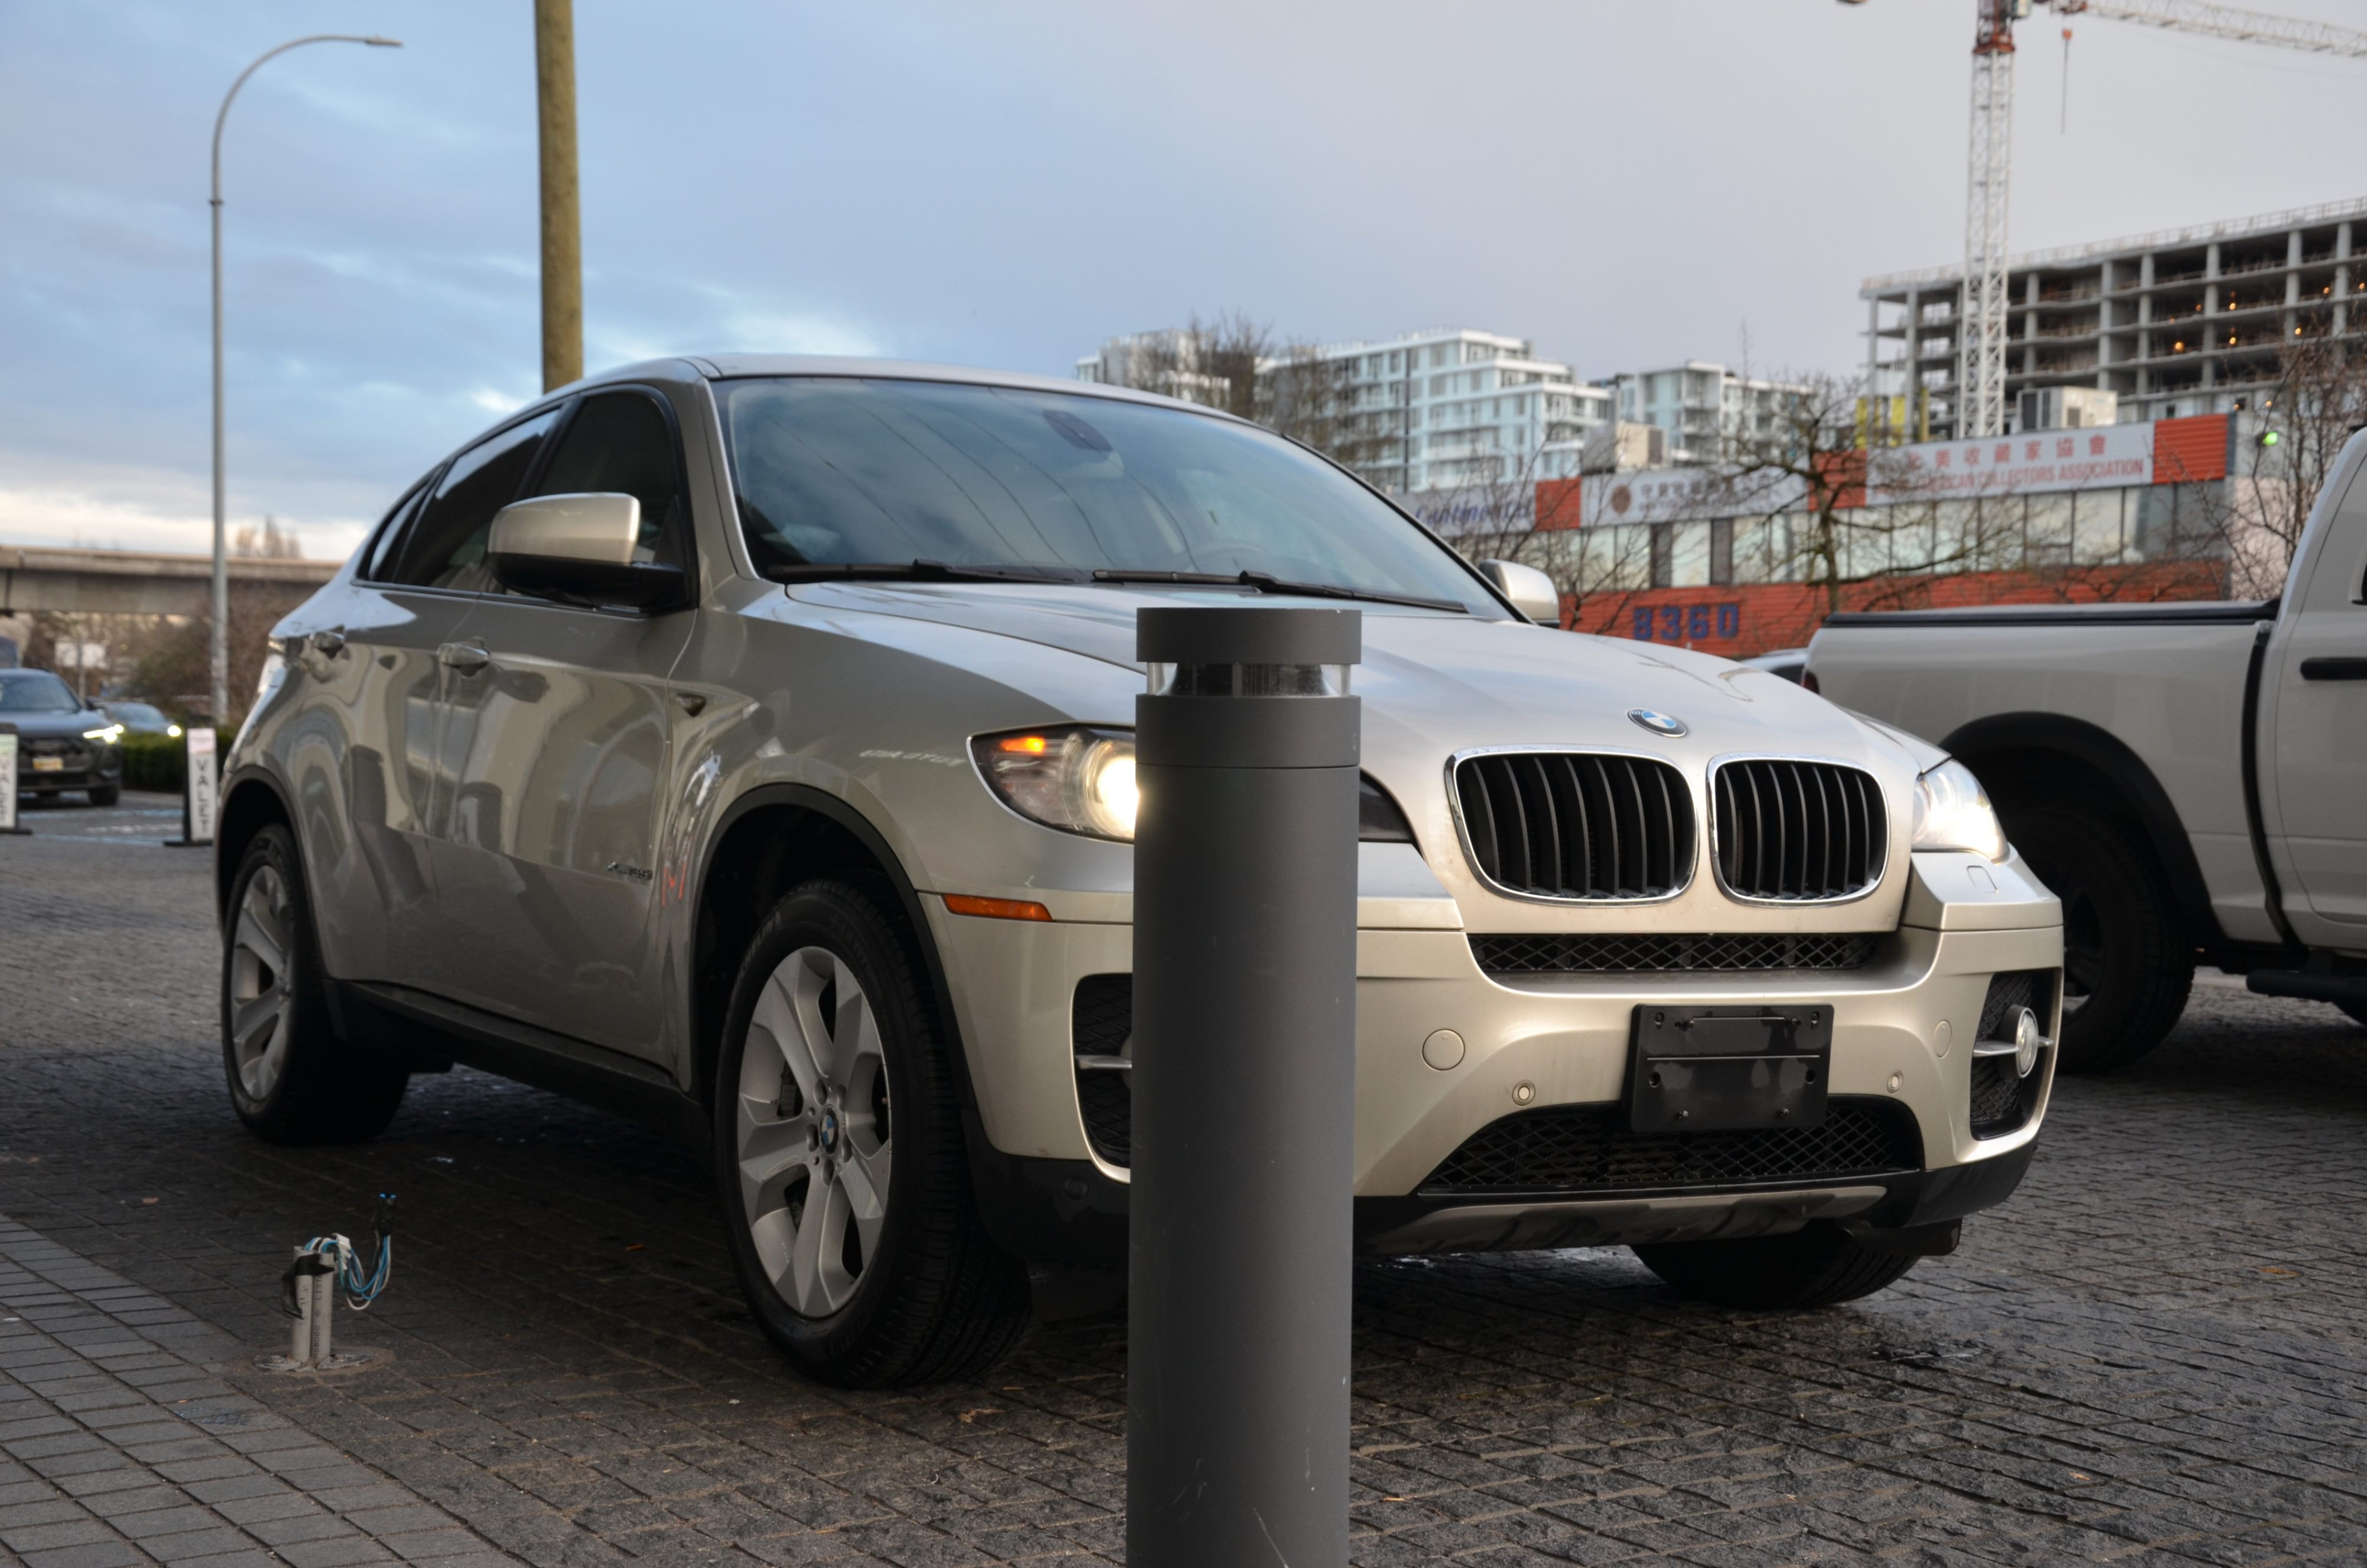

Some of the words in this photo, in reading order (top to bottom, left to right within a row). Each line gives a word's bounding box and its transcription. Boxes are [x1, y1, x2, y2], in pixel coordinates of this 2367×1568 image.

[2059, 458, 2144, 480] ASSOCIATION
[1633, 603, 1739, 640] 8360
[196, 758, 209, 833] VALET
